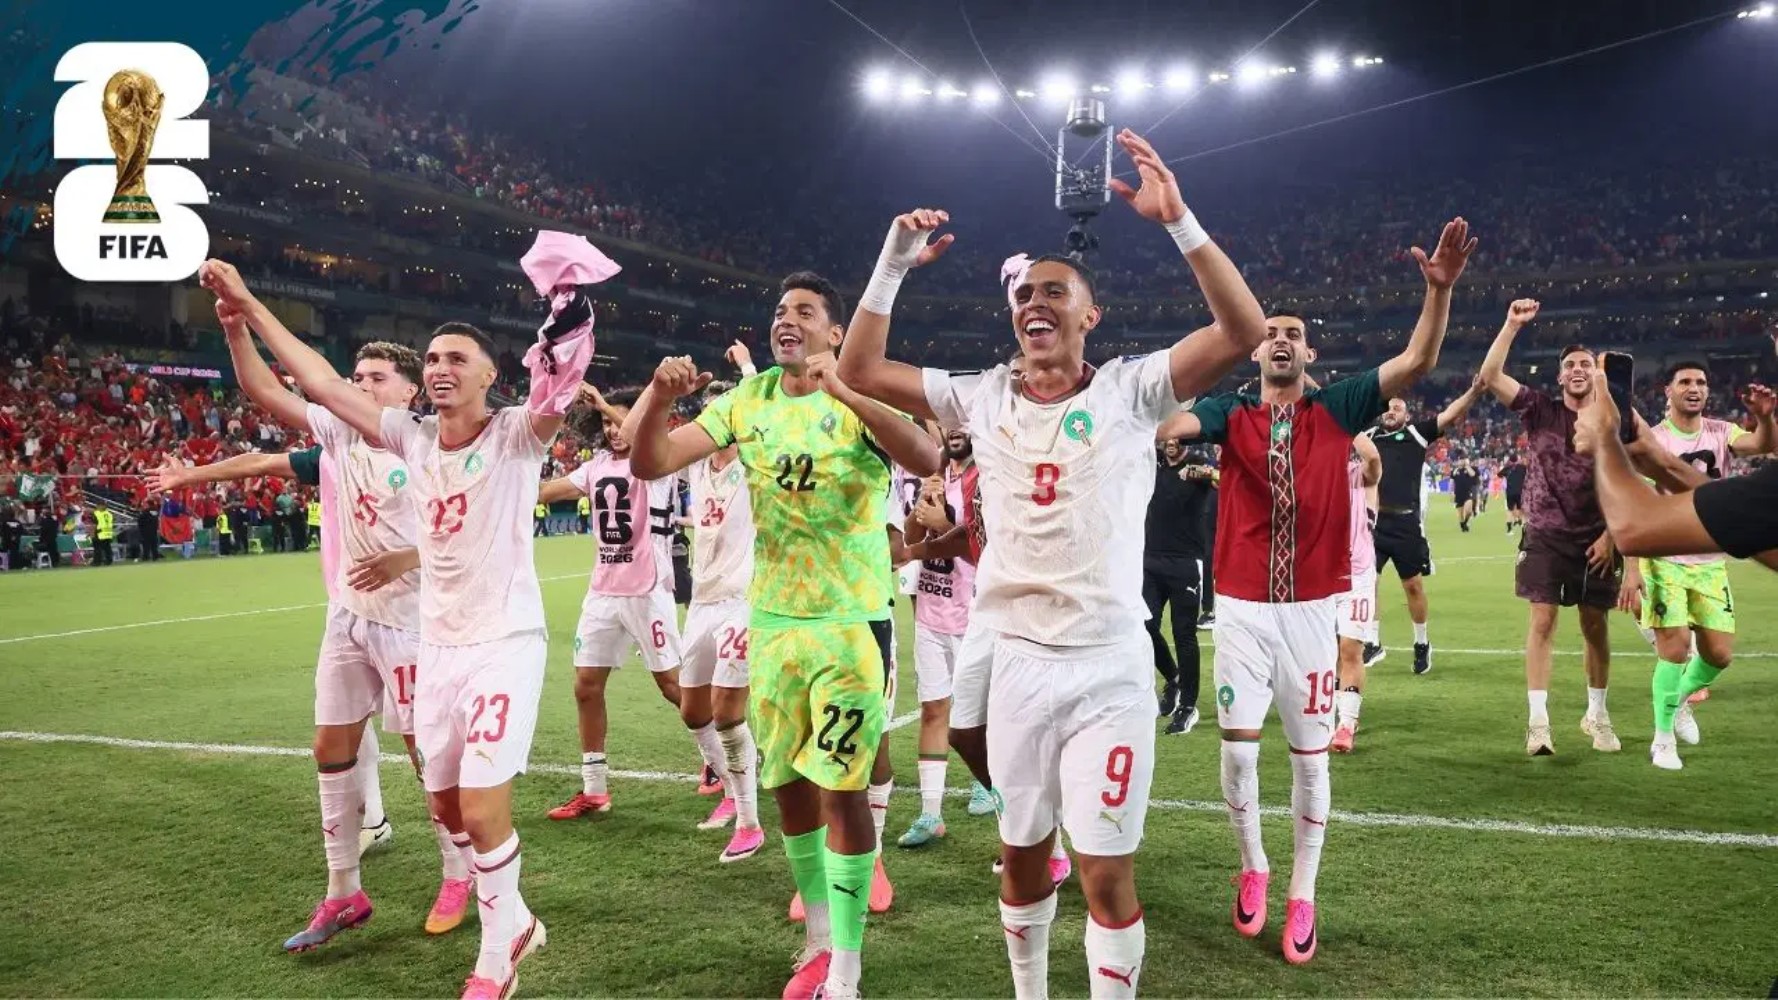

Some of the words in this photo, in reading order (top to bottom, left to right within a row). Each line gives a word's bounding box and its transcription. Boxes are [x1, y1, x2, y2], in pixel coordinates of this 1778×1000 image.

[775, 453, 817, 492] 22
[1031, 463, 1060, 506] 9
[427, 492, 468, 537] 23
[600, 553, 633, 565] 2026
[918, 580, 953, 598] 2026
[1349, 598, 1370, 622] 10
[651, 620, 666, 649] 6
[718, 626, 748, 660] 24
[1303, 669, 1335, 715] 19
[466, 693, 511, 743] 23
[817, 703, 865, 755] 22
[1101, 746, 1134, 807] 9
